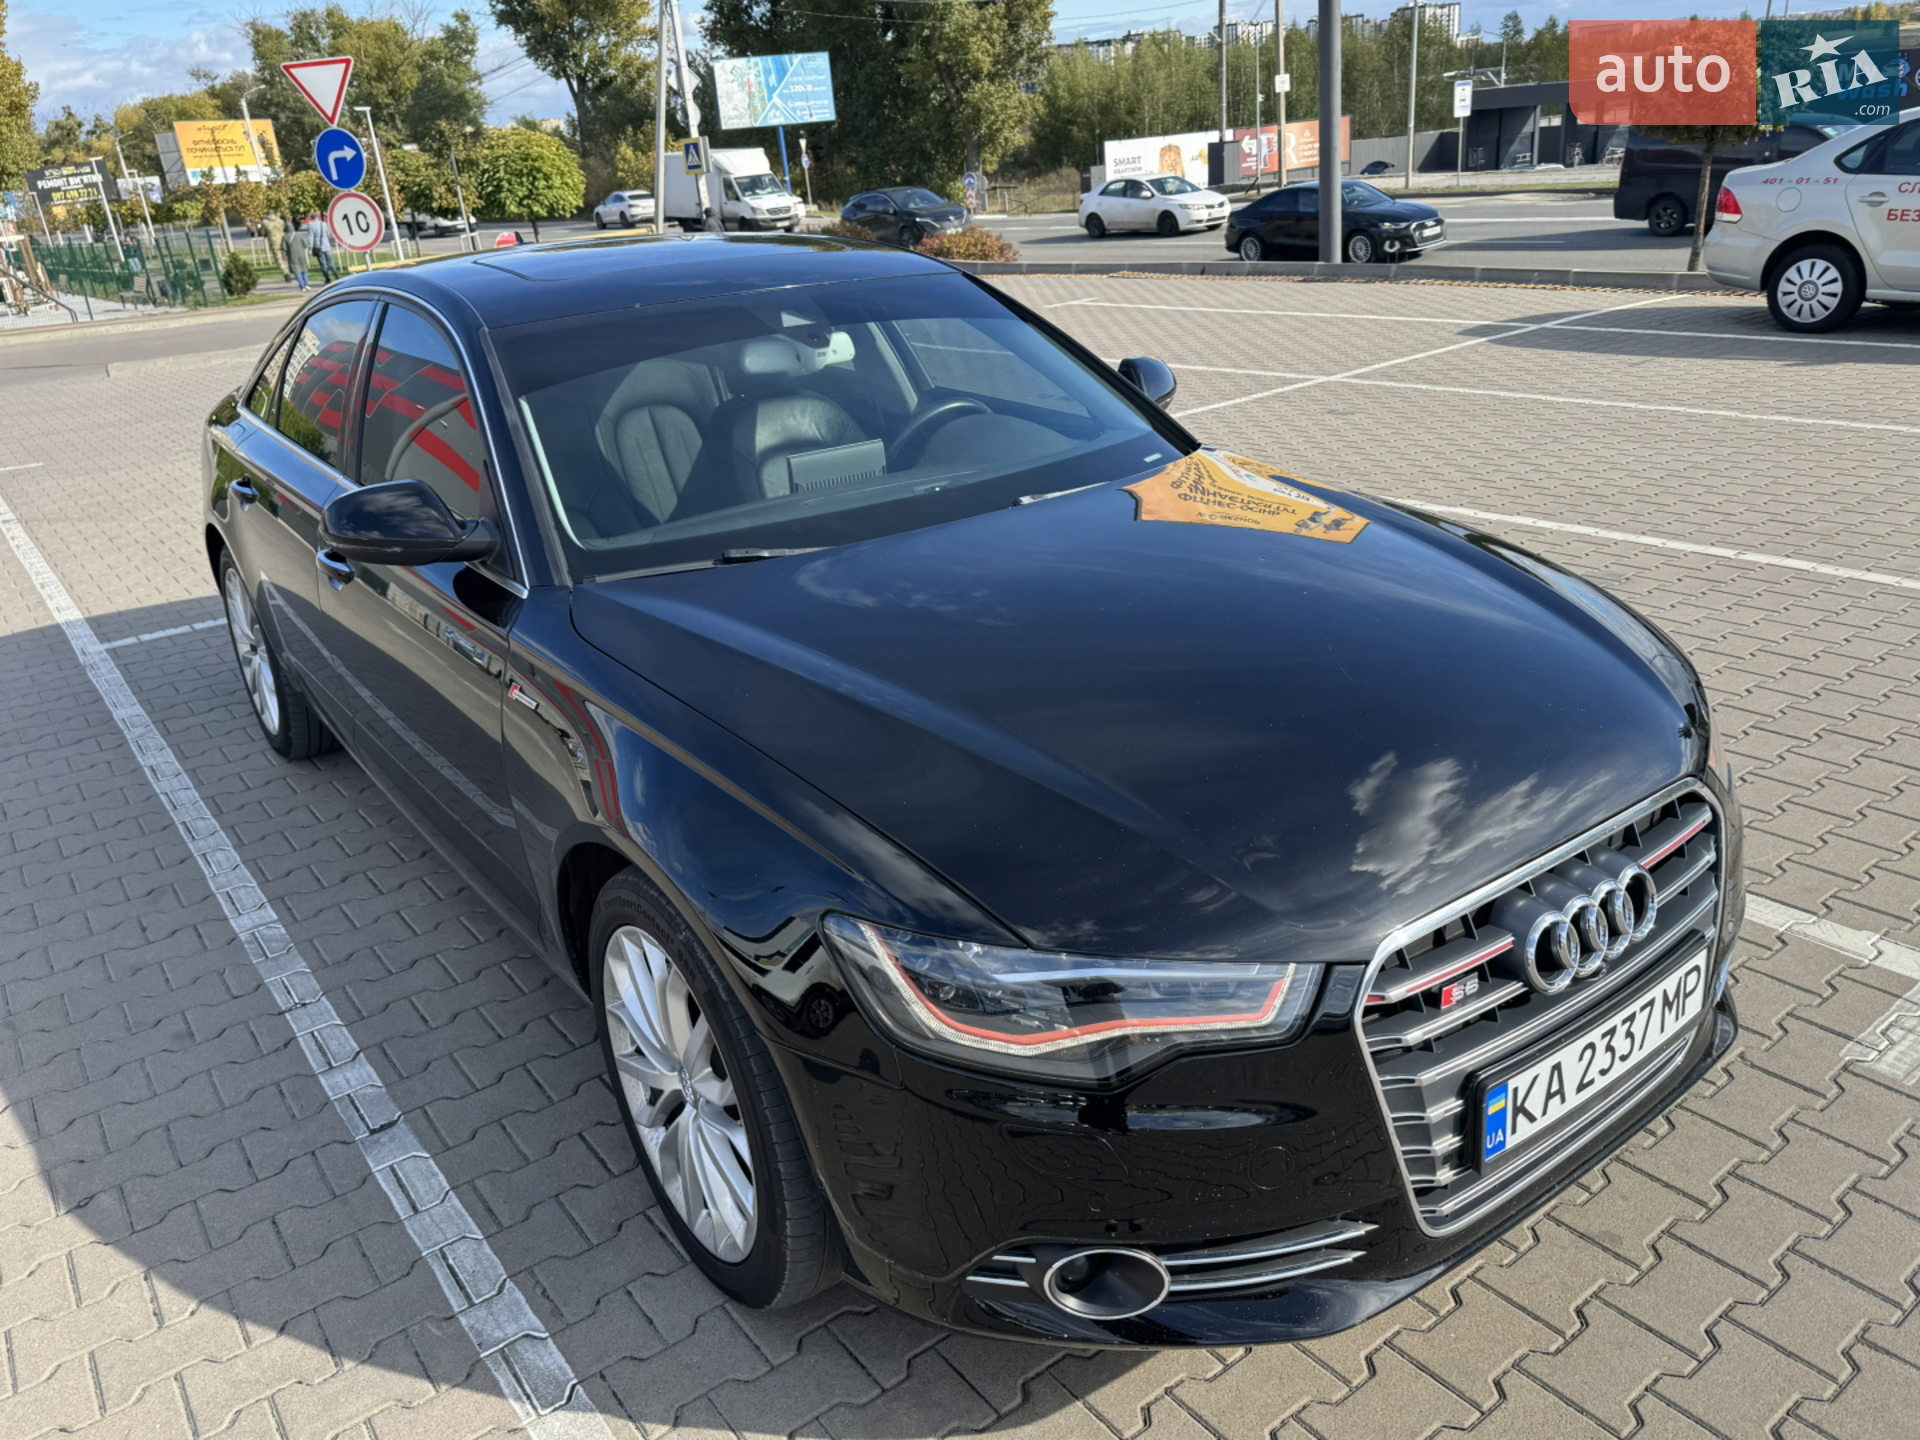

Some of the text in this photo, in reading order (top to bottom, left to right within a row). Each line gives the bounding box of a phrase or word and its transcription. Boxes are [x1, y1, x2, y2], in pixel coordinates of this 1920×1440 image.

[1112, 155, 1142, 167] SMART
[36, 175, 68, 190] РЕМОНТ
[1761, 177, 1785, 185] 401
[1822, 177, 1839, 185] 51
[341, 210, 371, 236] 10
[1449, 977, 1480, 1005] S6
[1510, 963, 1702, 1136] KA 2337 MP
[1486, 1127, 1505, 1149] UA
